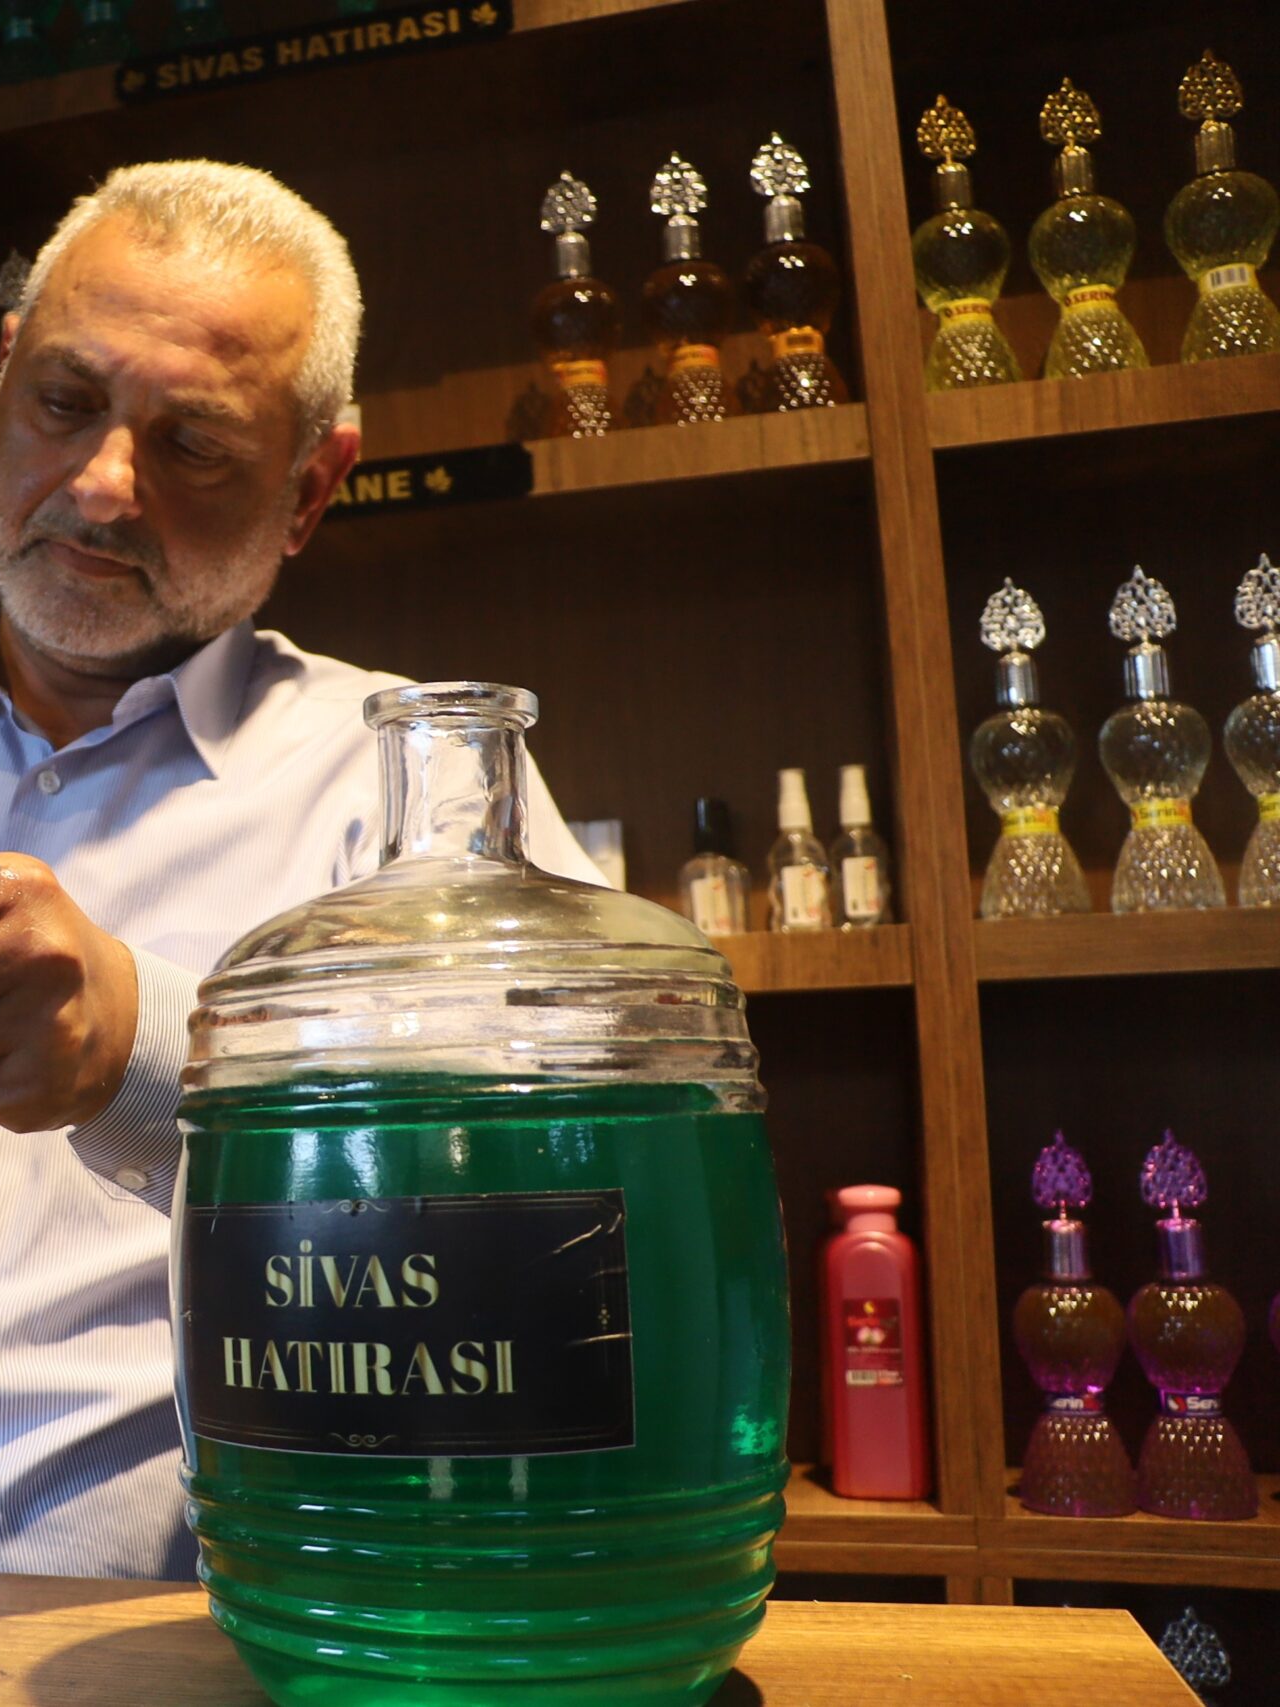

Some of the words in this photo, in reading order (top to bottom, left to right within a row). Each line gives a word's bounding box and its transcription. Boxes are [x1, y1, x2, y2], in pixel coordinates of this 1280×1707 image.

[157, 46, 264, 90] SİVAS
[277, 8, 461, 66] HATIRASI
[265, 1239, 440, 1308] SİVAS
[222, 1336, 519, 1396] HATIRASI
